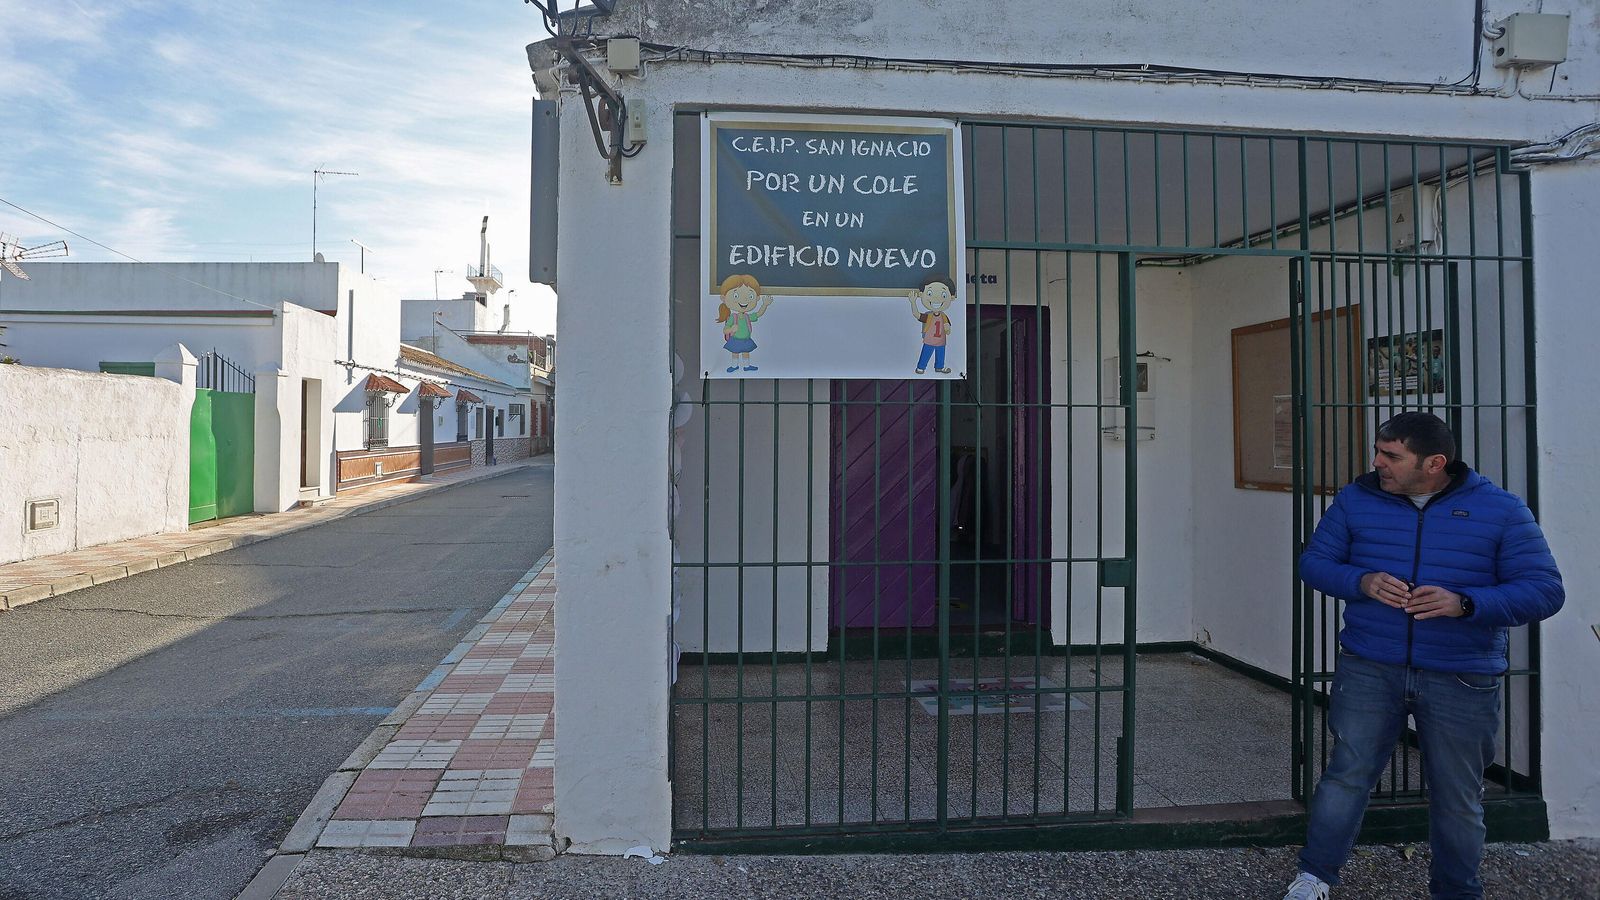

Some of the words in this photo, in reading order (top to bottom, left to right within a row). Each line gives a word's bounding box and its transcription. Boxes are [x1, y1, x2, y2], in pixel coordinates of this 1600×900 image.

[732, 136, 799, 154] C.E.I.P.
[805, 138, 845, 156] SAN
[851, 139, 931, 158] IGNACIO
[746, 170, 800, 193] POR
[808, 173, 845, 194] UN
[852, 175, 918, 195] COLE
[802, 210, 829, 227] EN
[835, 212, 864, 228] UN
[729, 244, 840, 267] EDIFICIO
[847, 247, 936, 269] NUEVO
[934, 320, 941, 337] 1
